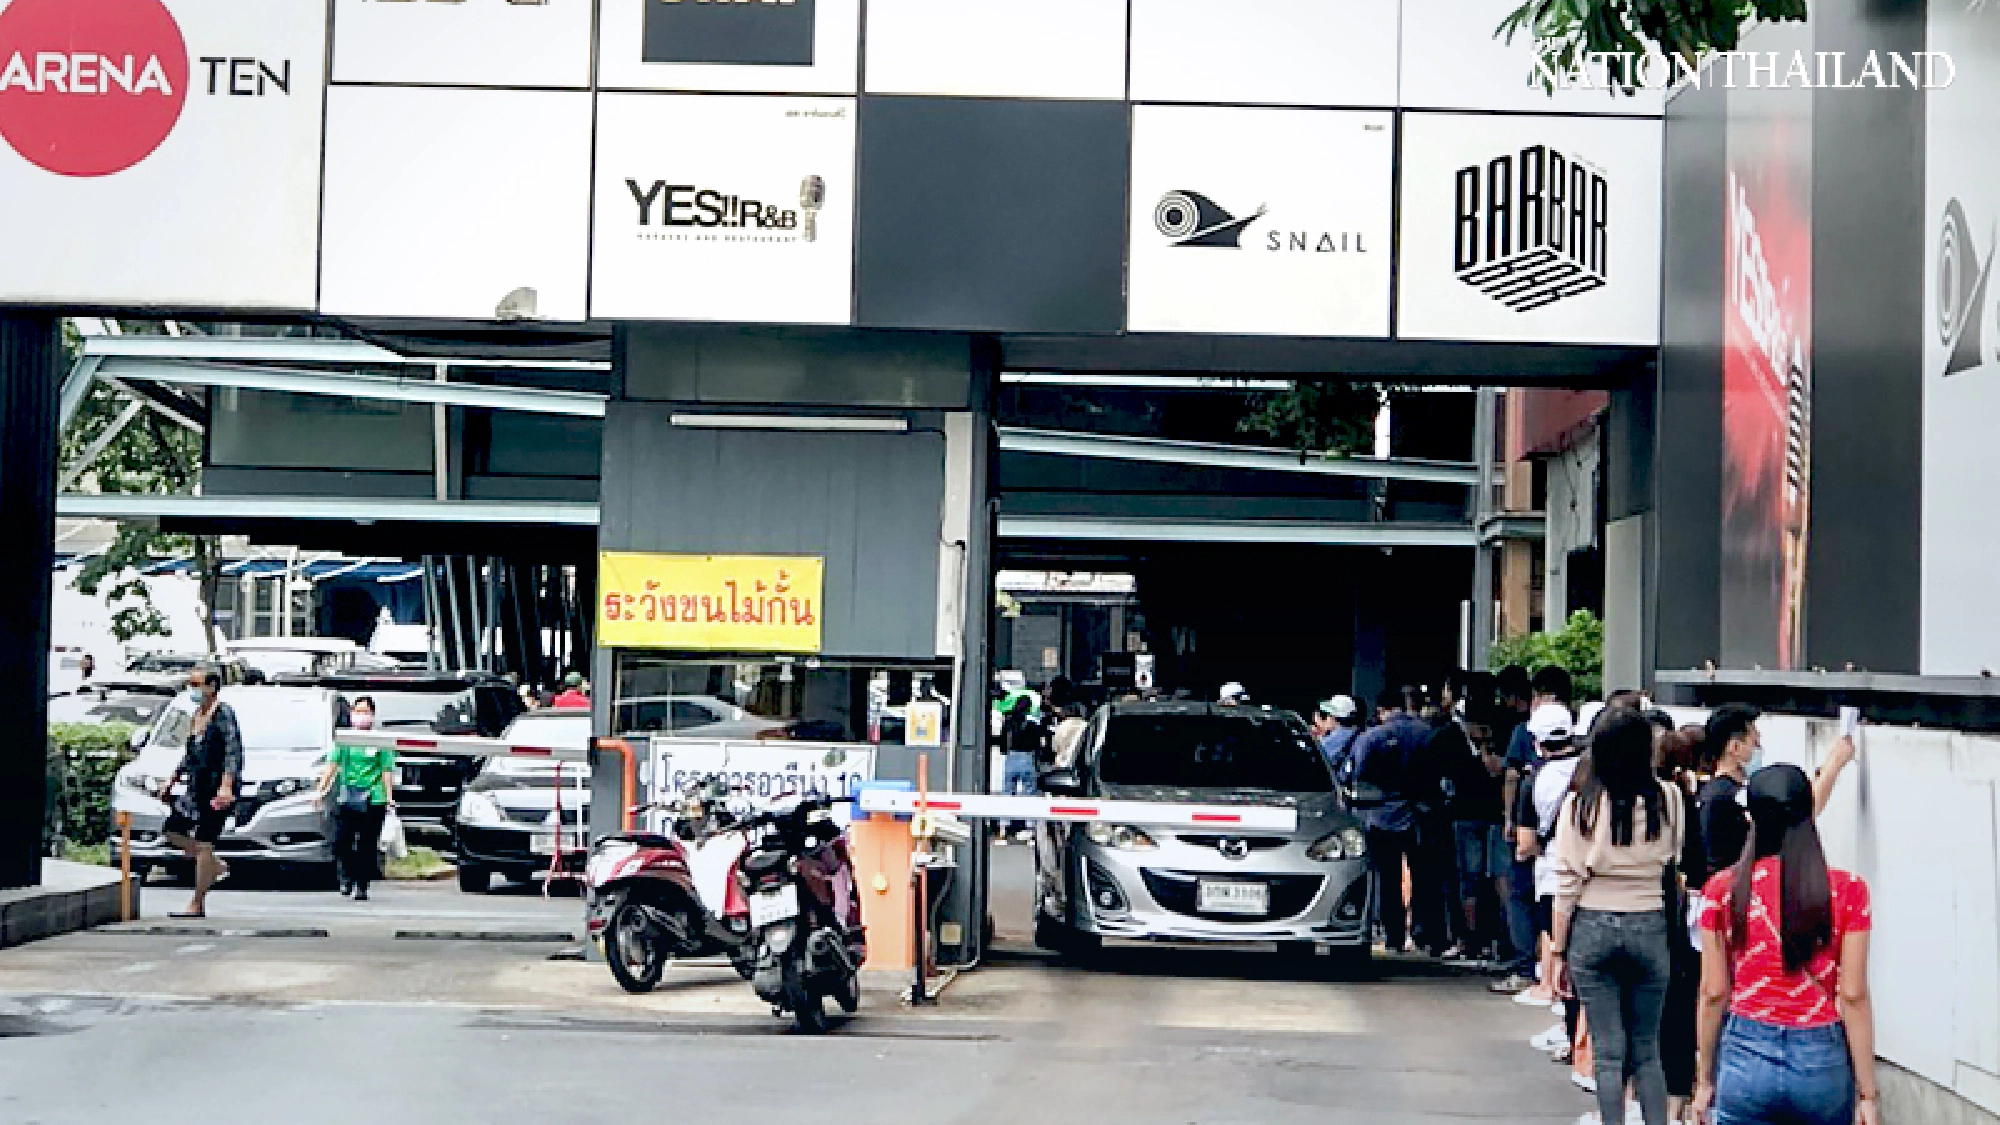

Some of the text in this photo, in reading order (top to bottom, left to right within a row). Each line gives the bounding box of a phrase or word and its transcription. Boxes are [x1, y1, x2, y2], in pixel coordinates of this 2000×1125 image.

[0, 51, 291, 96] ARENA TEN
[1266, 230, 1368, 253] SNAIL
